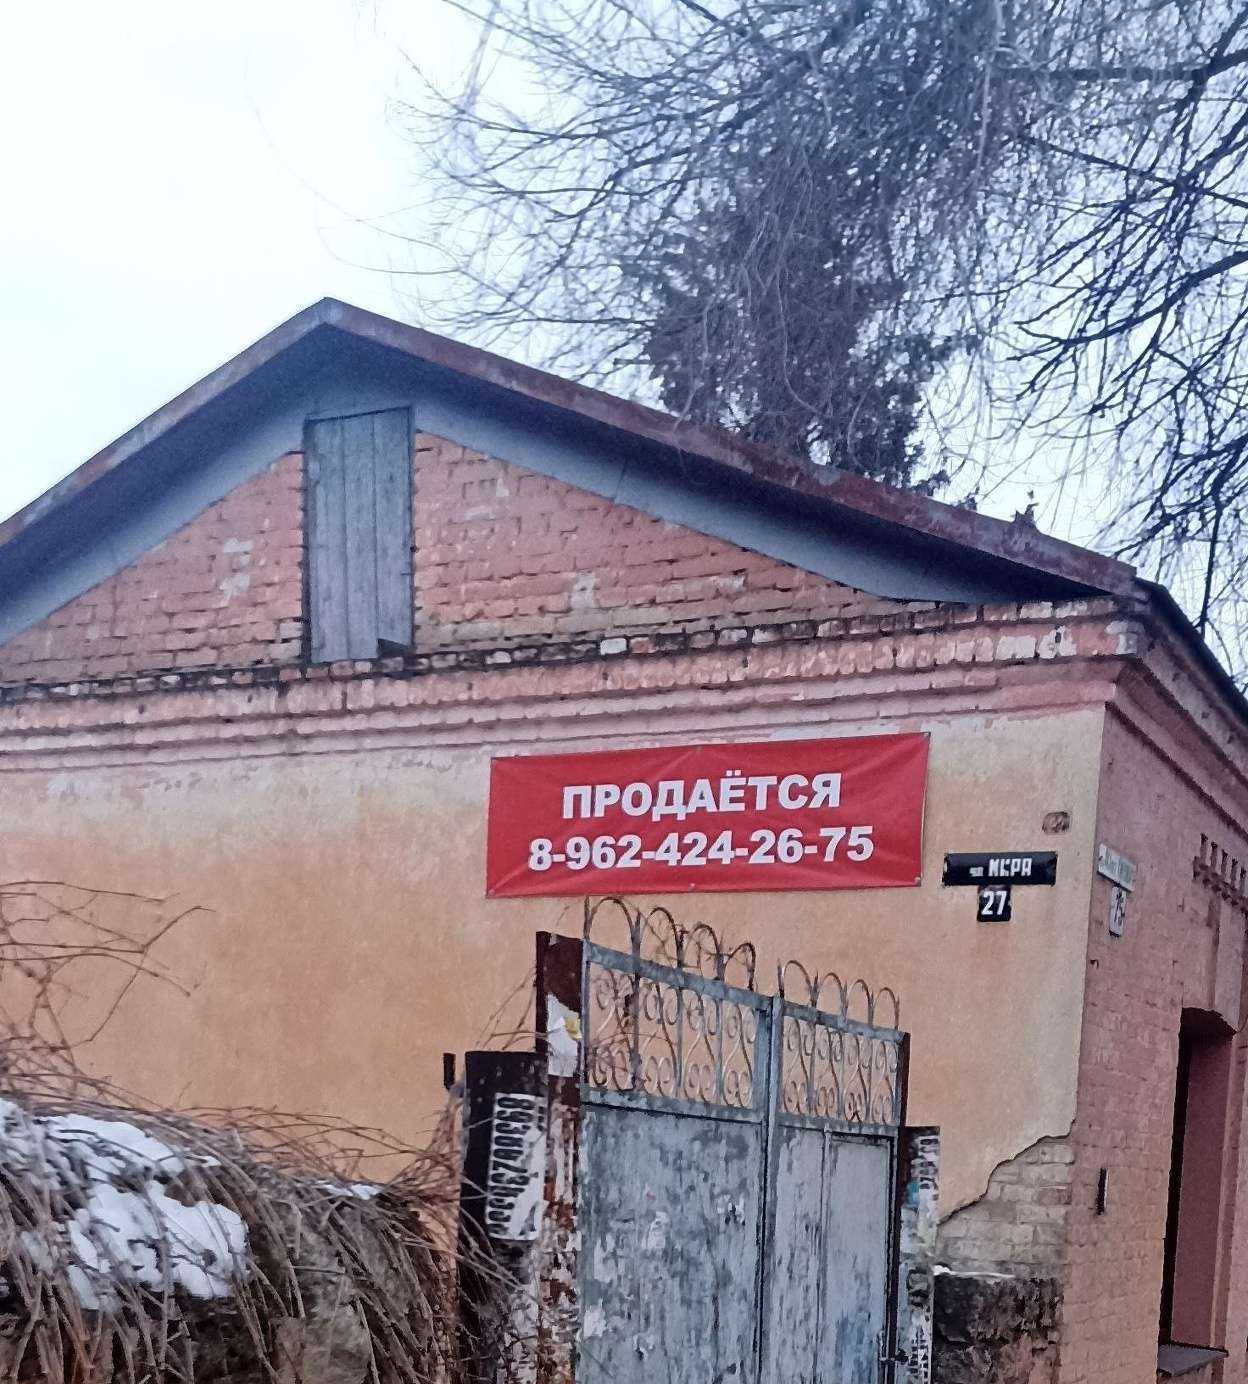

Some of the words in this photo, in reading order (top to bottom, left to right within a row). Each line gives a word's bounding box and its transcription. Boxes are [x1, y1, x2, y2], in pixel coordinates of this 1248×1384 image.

[562, 770, 842, 822] ПРОДАЁТСЯ
[528, 826, 874, 871] 8-962-424-26-75
[981, 890, 1008, 916] 27
